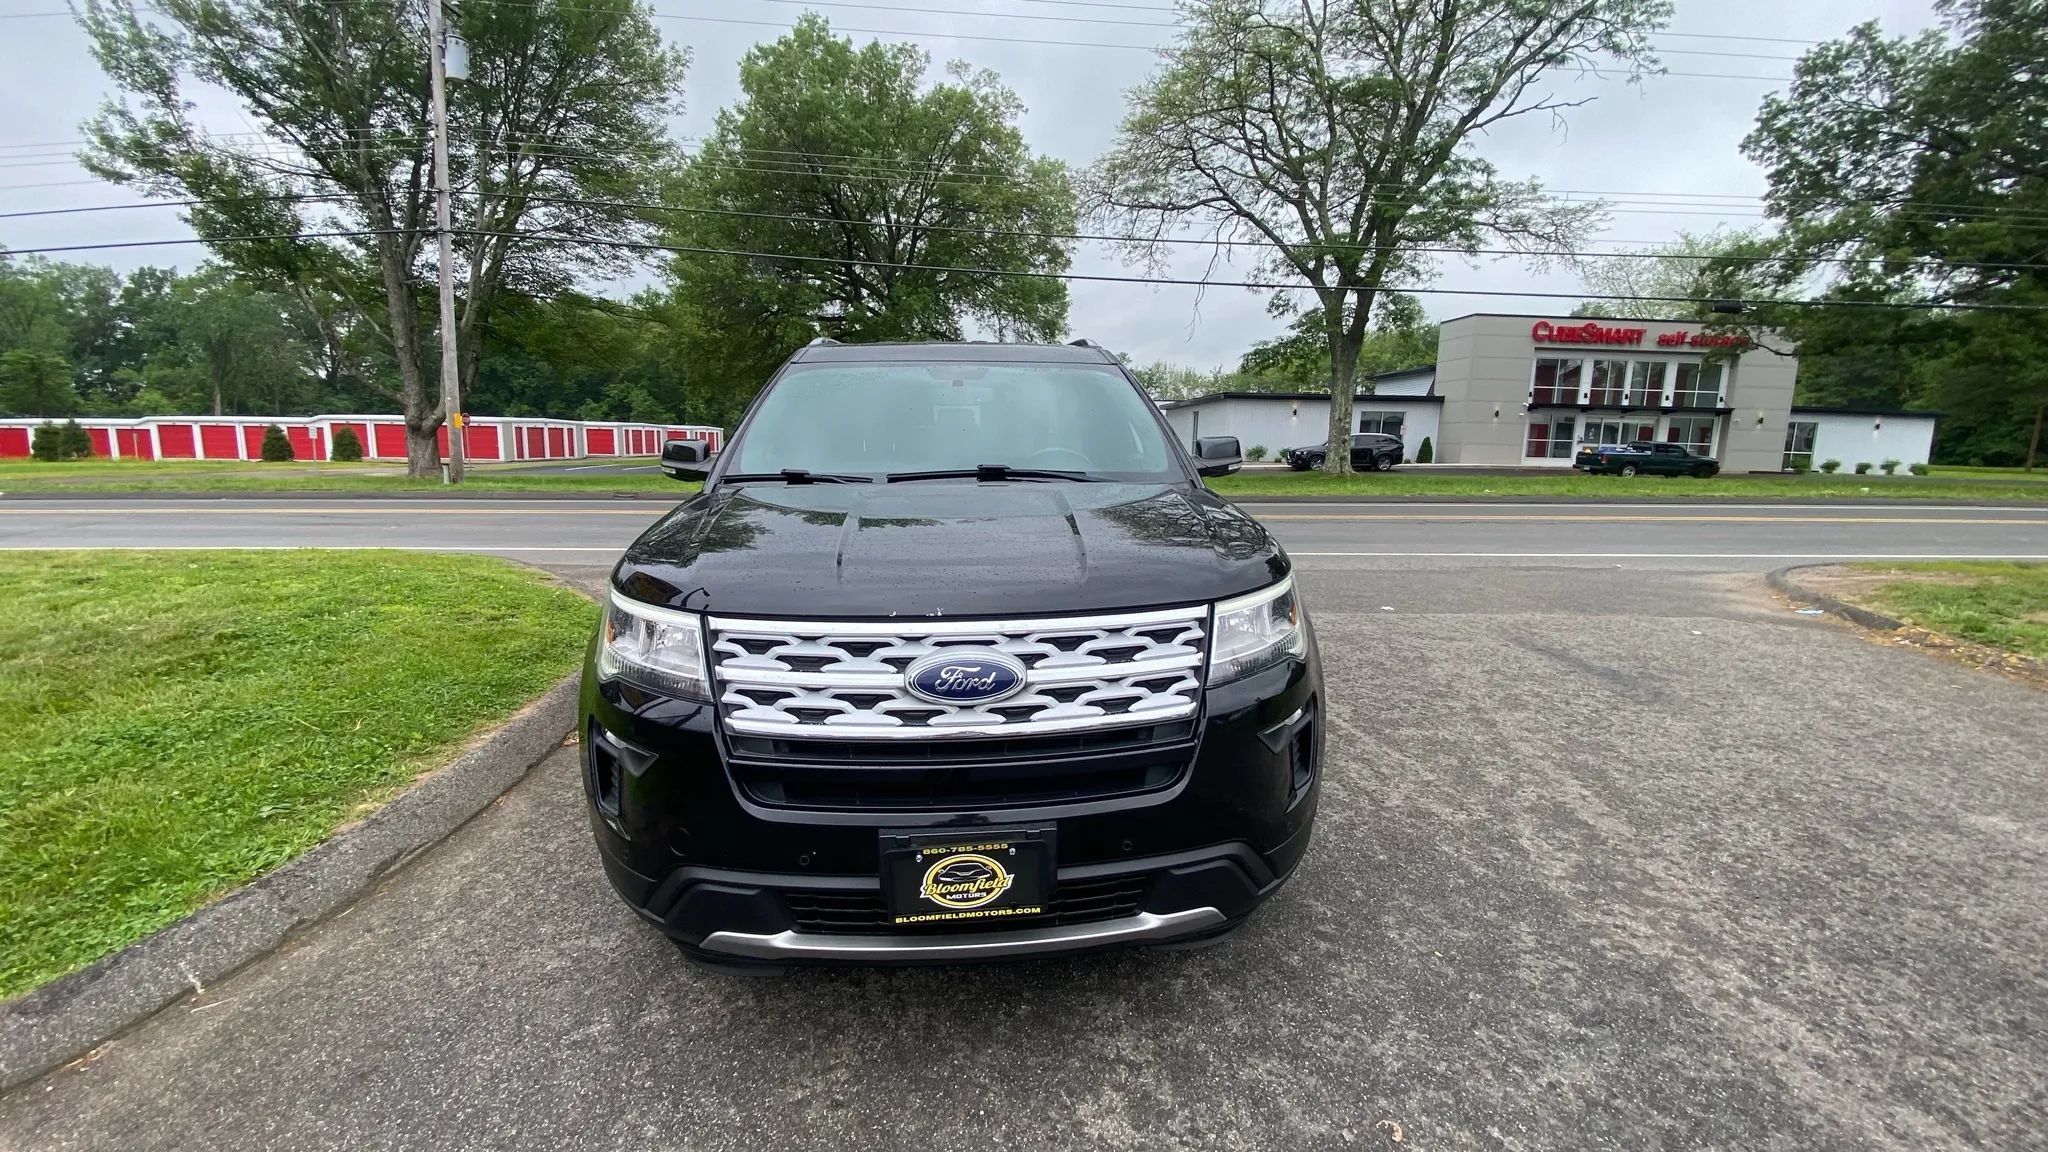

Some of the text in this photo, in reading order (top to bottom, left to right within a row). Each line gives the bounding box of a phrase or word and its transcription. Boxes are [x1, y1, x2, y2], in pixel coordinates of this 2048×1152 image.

[1657, 330, 1688, 346] self
[934, 665, 996, 692] Ford
[922, 843, 1009, 855] 860-785-5555
[924, 876, 1010, 896] Bloomfield
[946, 892, 987, 900] MOTORS
[895, 907, 1041, 924] BLOOMFIELDMOTORS.COM
